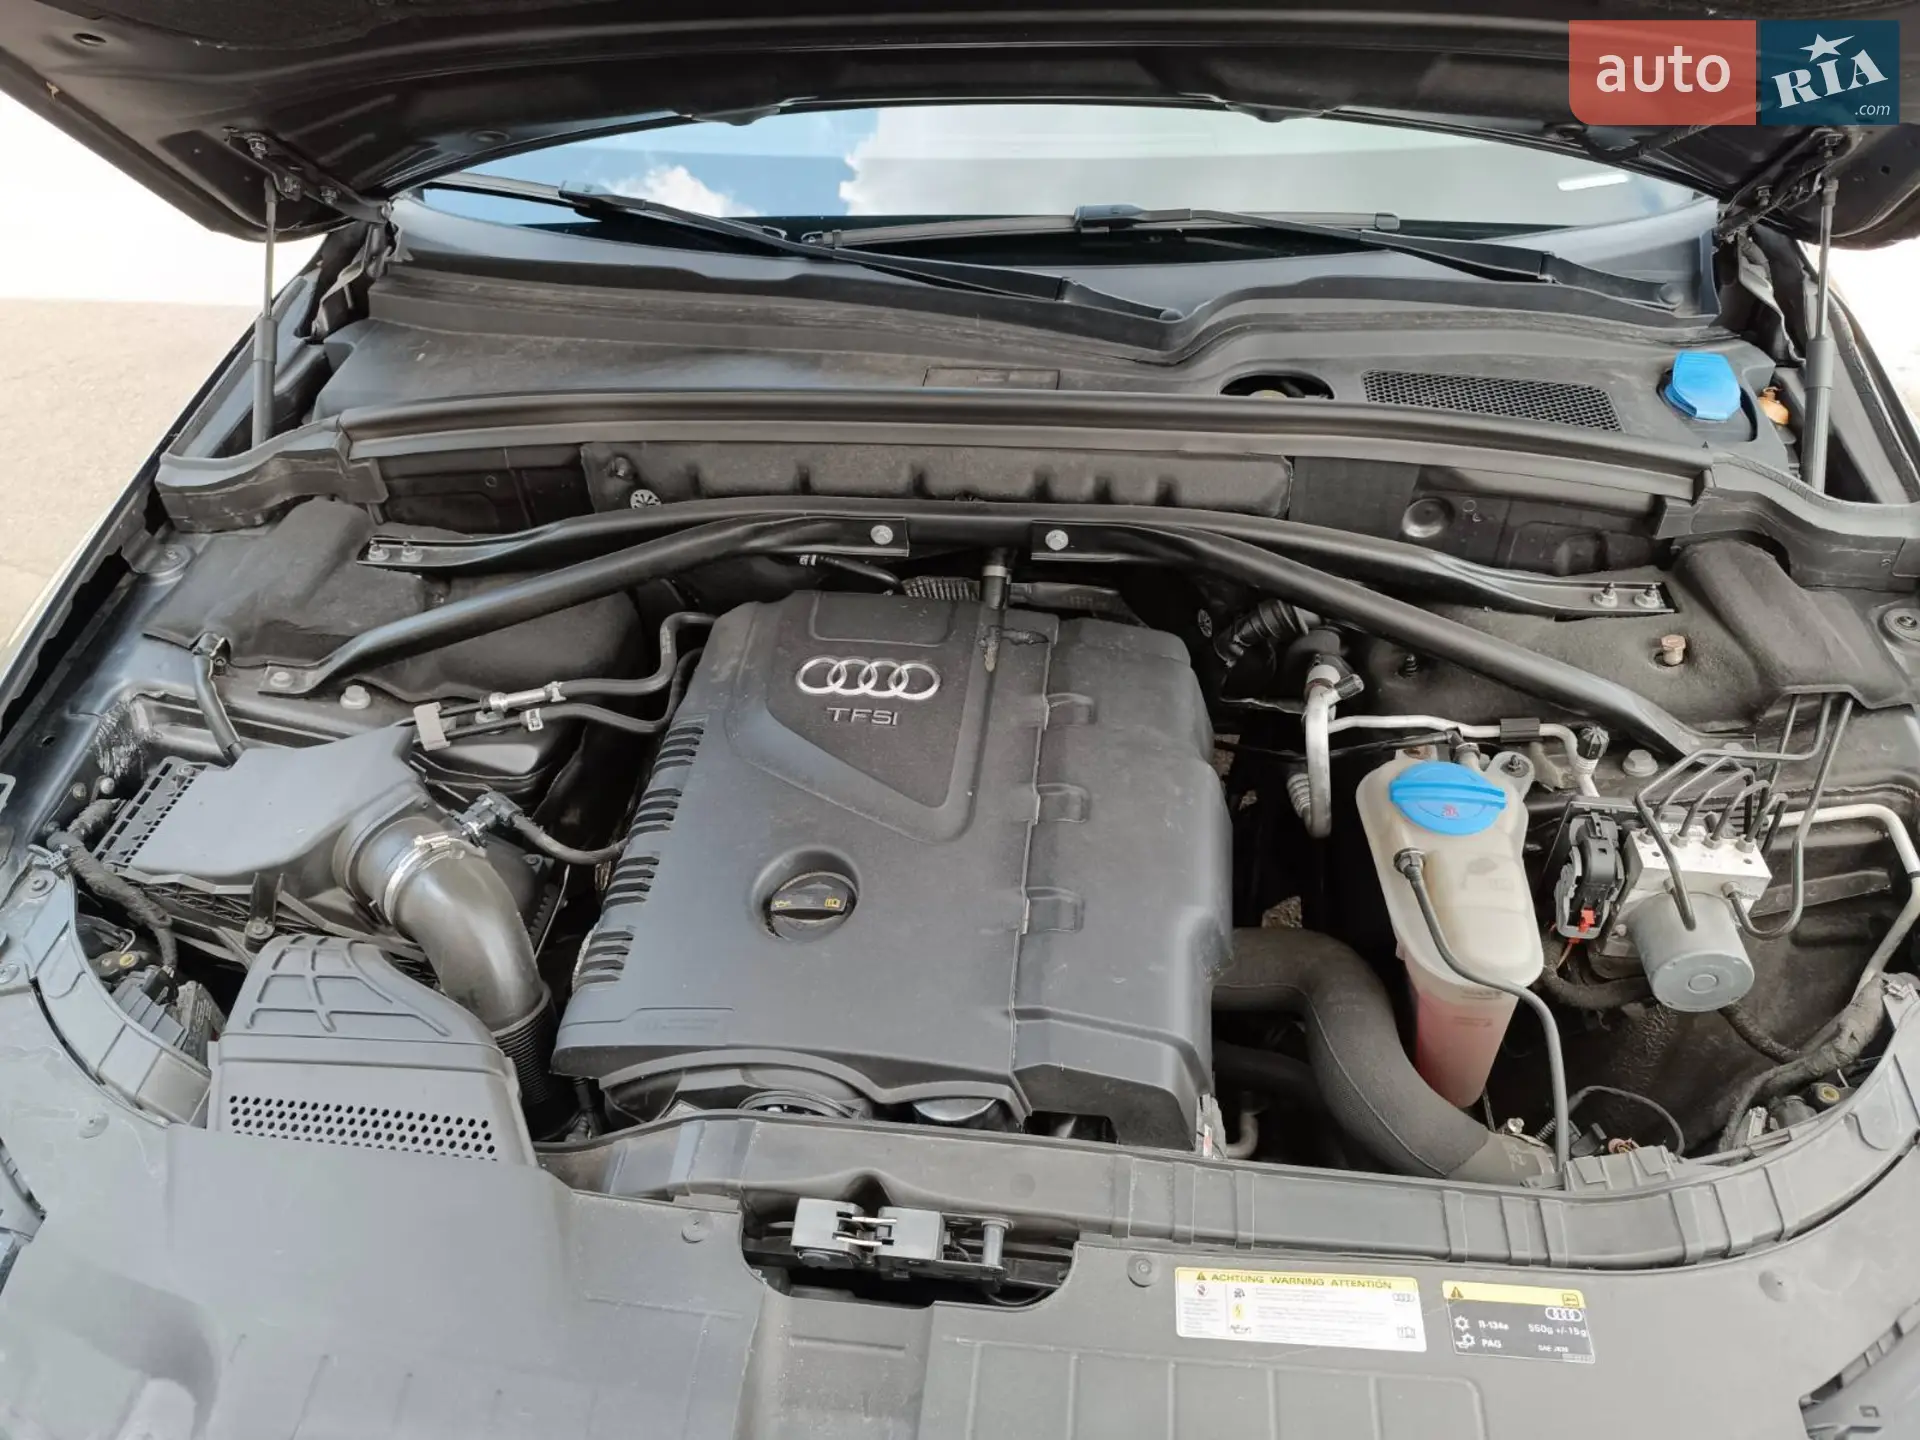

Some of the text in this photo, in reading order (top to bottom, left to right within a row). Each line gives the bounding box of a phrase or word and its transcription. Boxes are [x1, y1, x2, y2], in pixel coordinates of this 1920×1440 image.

[827, 707, 898, 726] TFSI
[1211, 1273, 1392, 1289] ACHTUNG WARNING ATTENTION
